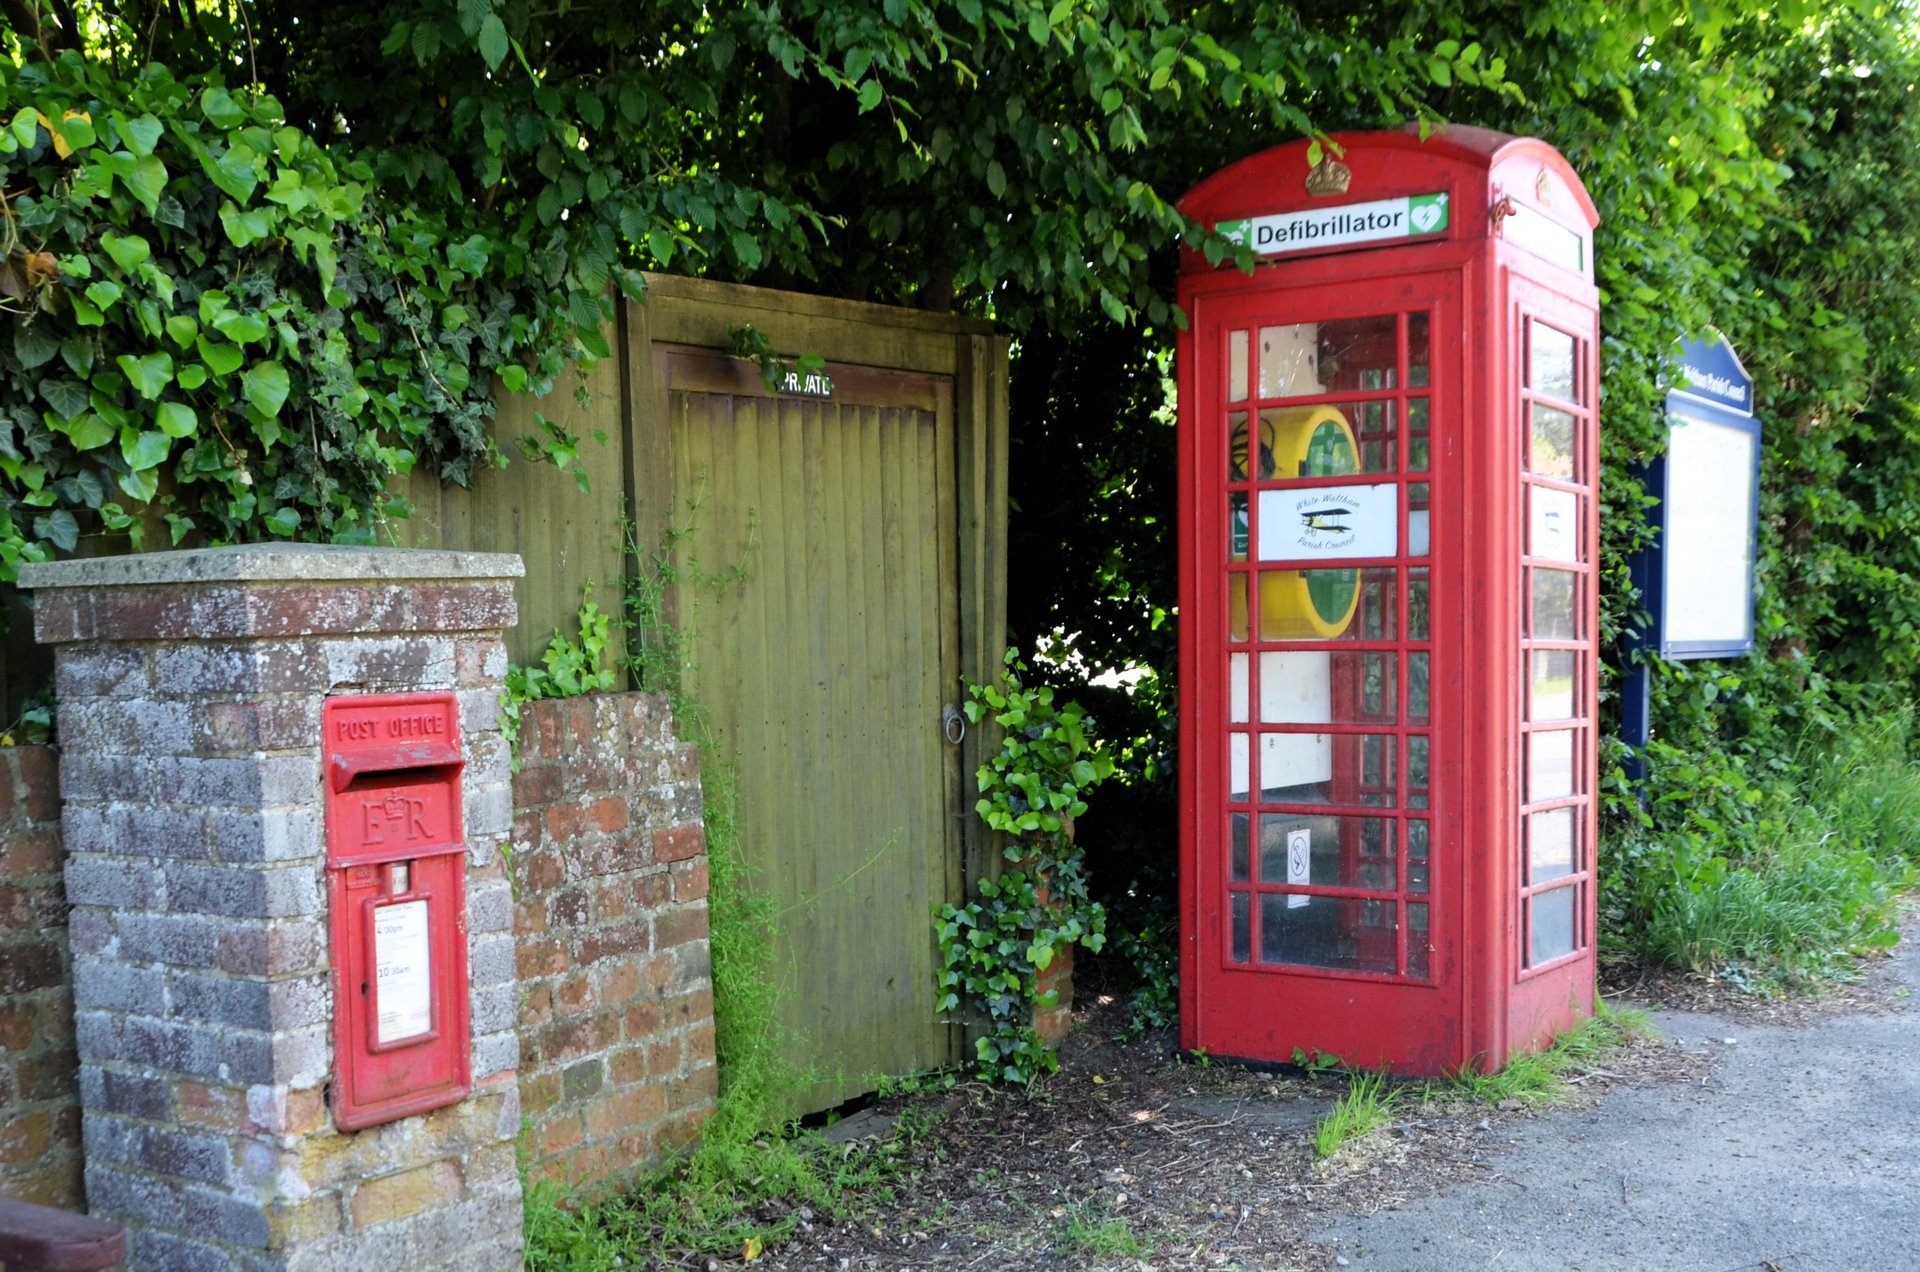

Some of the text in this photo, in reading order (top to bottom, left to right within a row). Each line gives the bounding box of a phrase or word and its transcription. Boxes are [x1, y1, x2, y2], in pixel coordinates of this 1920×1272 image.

[1257, 211, 1403, 245] Defibrillator
[1296, 493, 1360, 511] White Waltham
[1297, 533, 1355, 550] Parish Council
[337, 715, 443, 741] POST OFFICE
